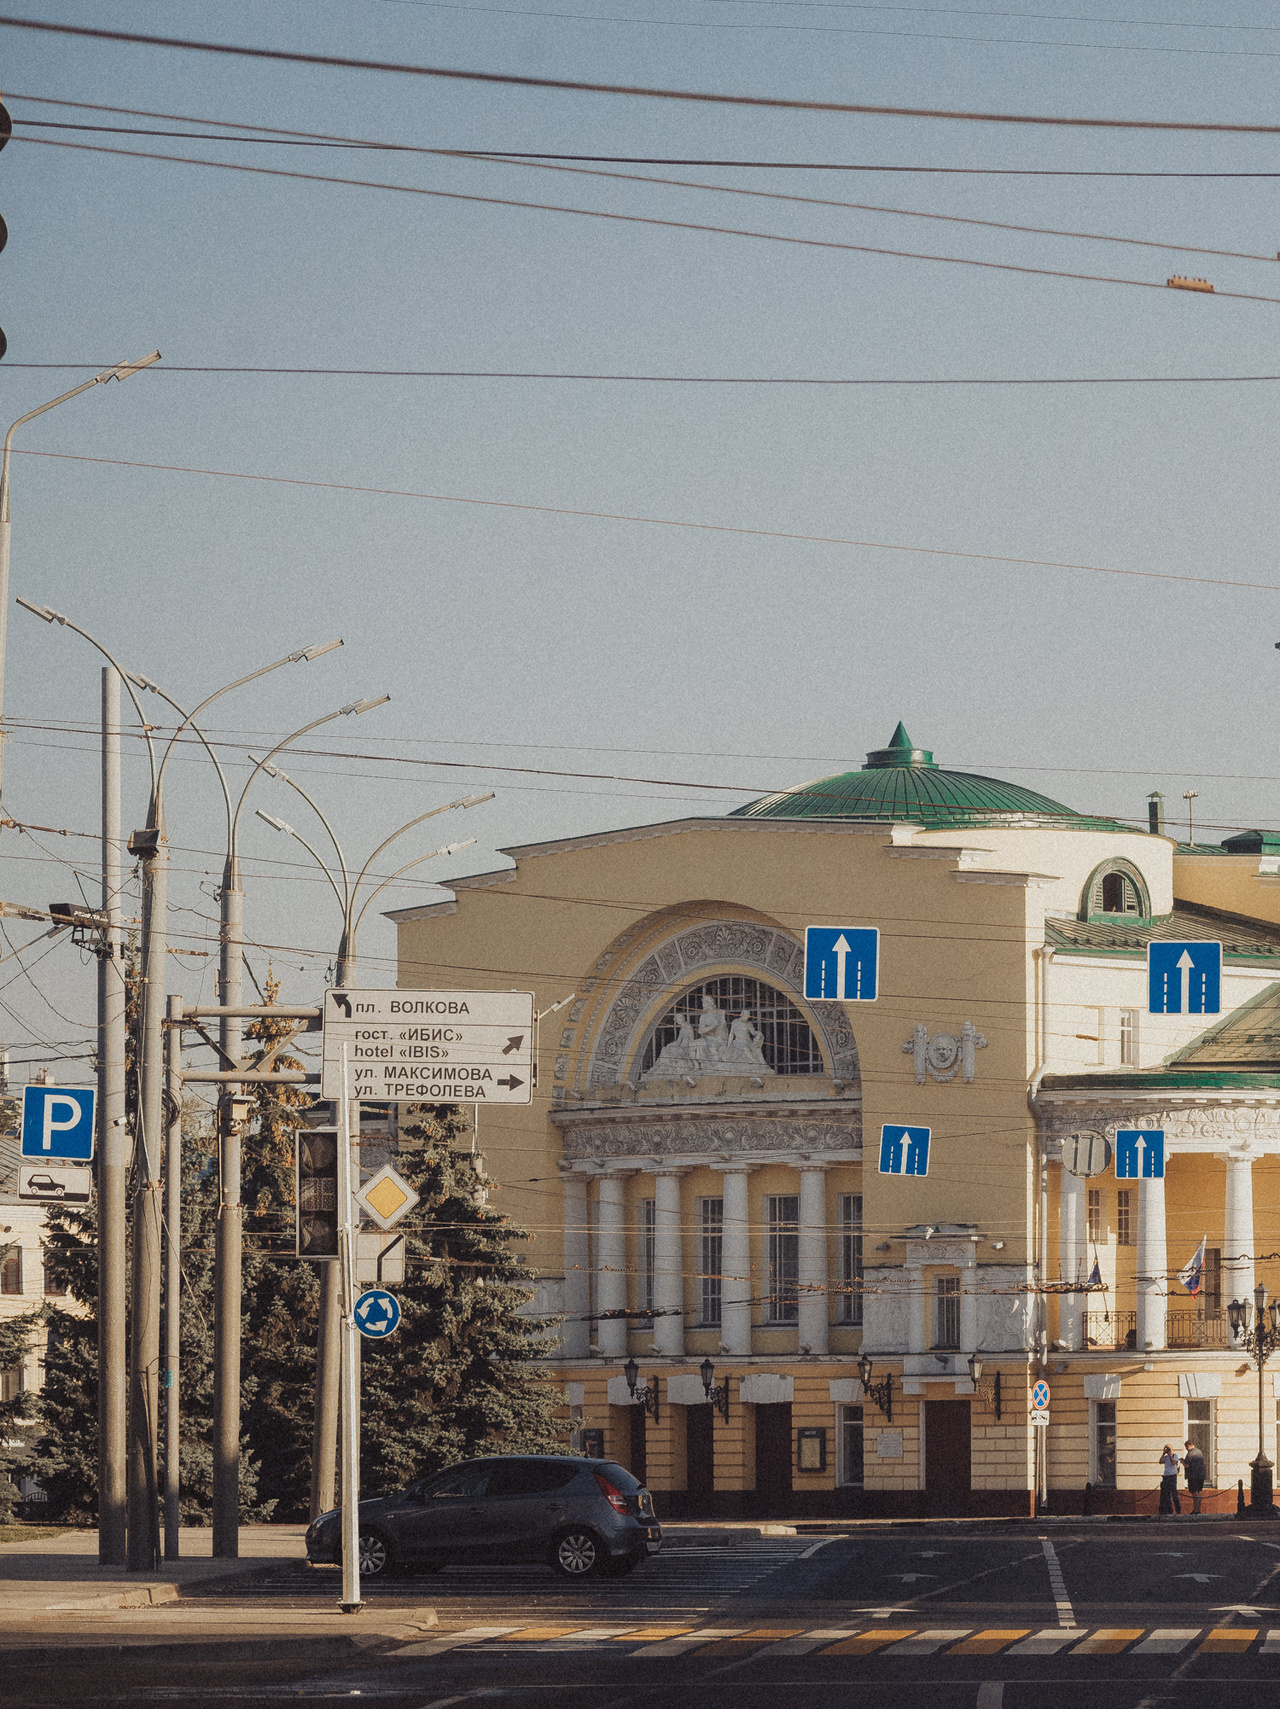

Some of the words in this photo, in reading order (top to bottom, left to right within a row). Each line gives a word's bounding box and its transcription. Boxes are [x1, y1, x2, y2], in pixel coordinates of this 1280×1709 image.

[355, 1003, 381, 1013] пл.
[390, 1000, 470, 1014] ВОЛКОВА
[355, 1030, 393, 1040] гост.
[399, 1028, 463, 1042] «ИБИС»
[354, 1045, 393, 1057] hotel
[399, 1045, 449, 1058] «IBIS»
[354, 1067, 378, 1081] ул.
[384, 1066, 493, 1081] МАКСИМОВА
[354, 1084, 378, 1098] ул.
[384, 1083, 486, 1098] ТРЕФОЛЕВА
[42, 1094, 82, 1150] P
